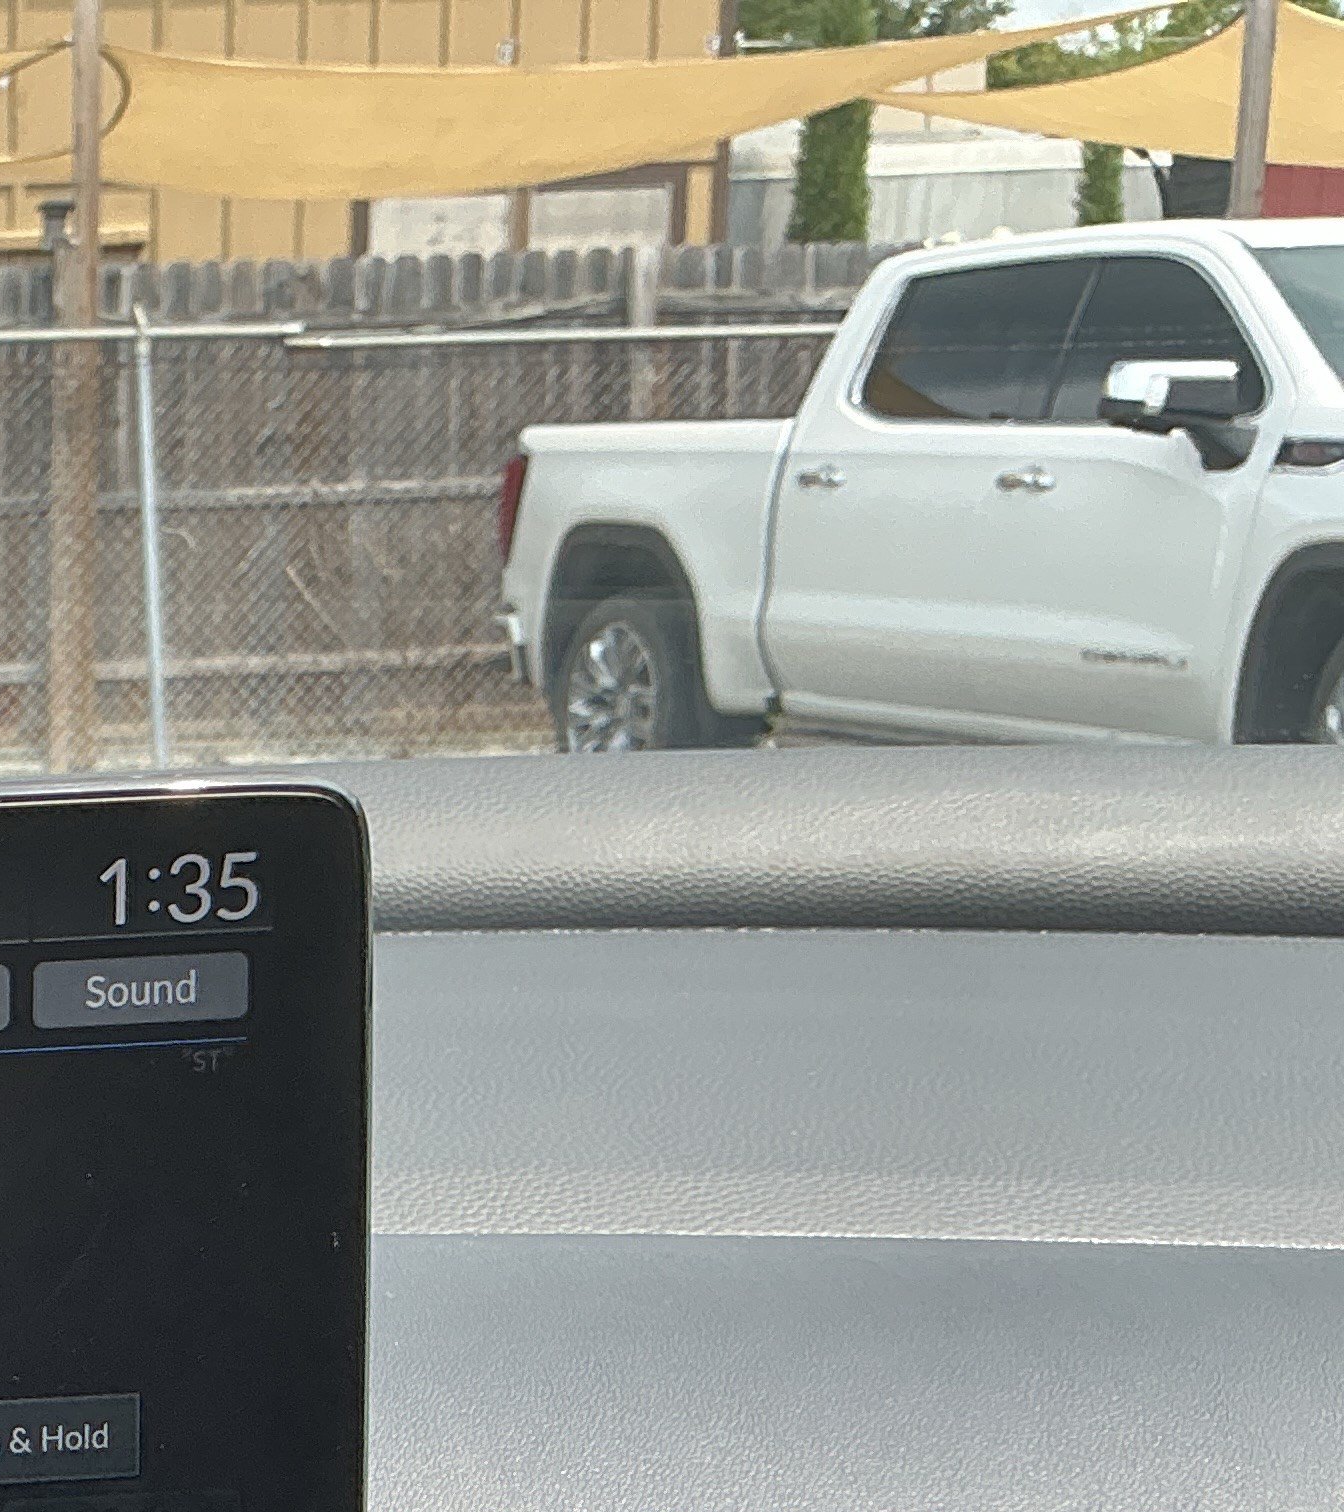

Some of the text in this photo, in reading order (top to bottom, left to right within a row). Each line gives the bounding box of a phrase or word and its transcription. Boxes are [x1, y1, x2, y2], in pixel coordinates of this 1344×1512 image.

[99, 851, 259, 926] 1:35
[85, 969, 196, 1009] Sound
[9, 1427, 32, 1454] &
[41, 1423, 109, 1452] Hold
